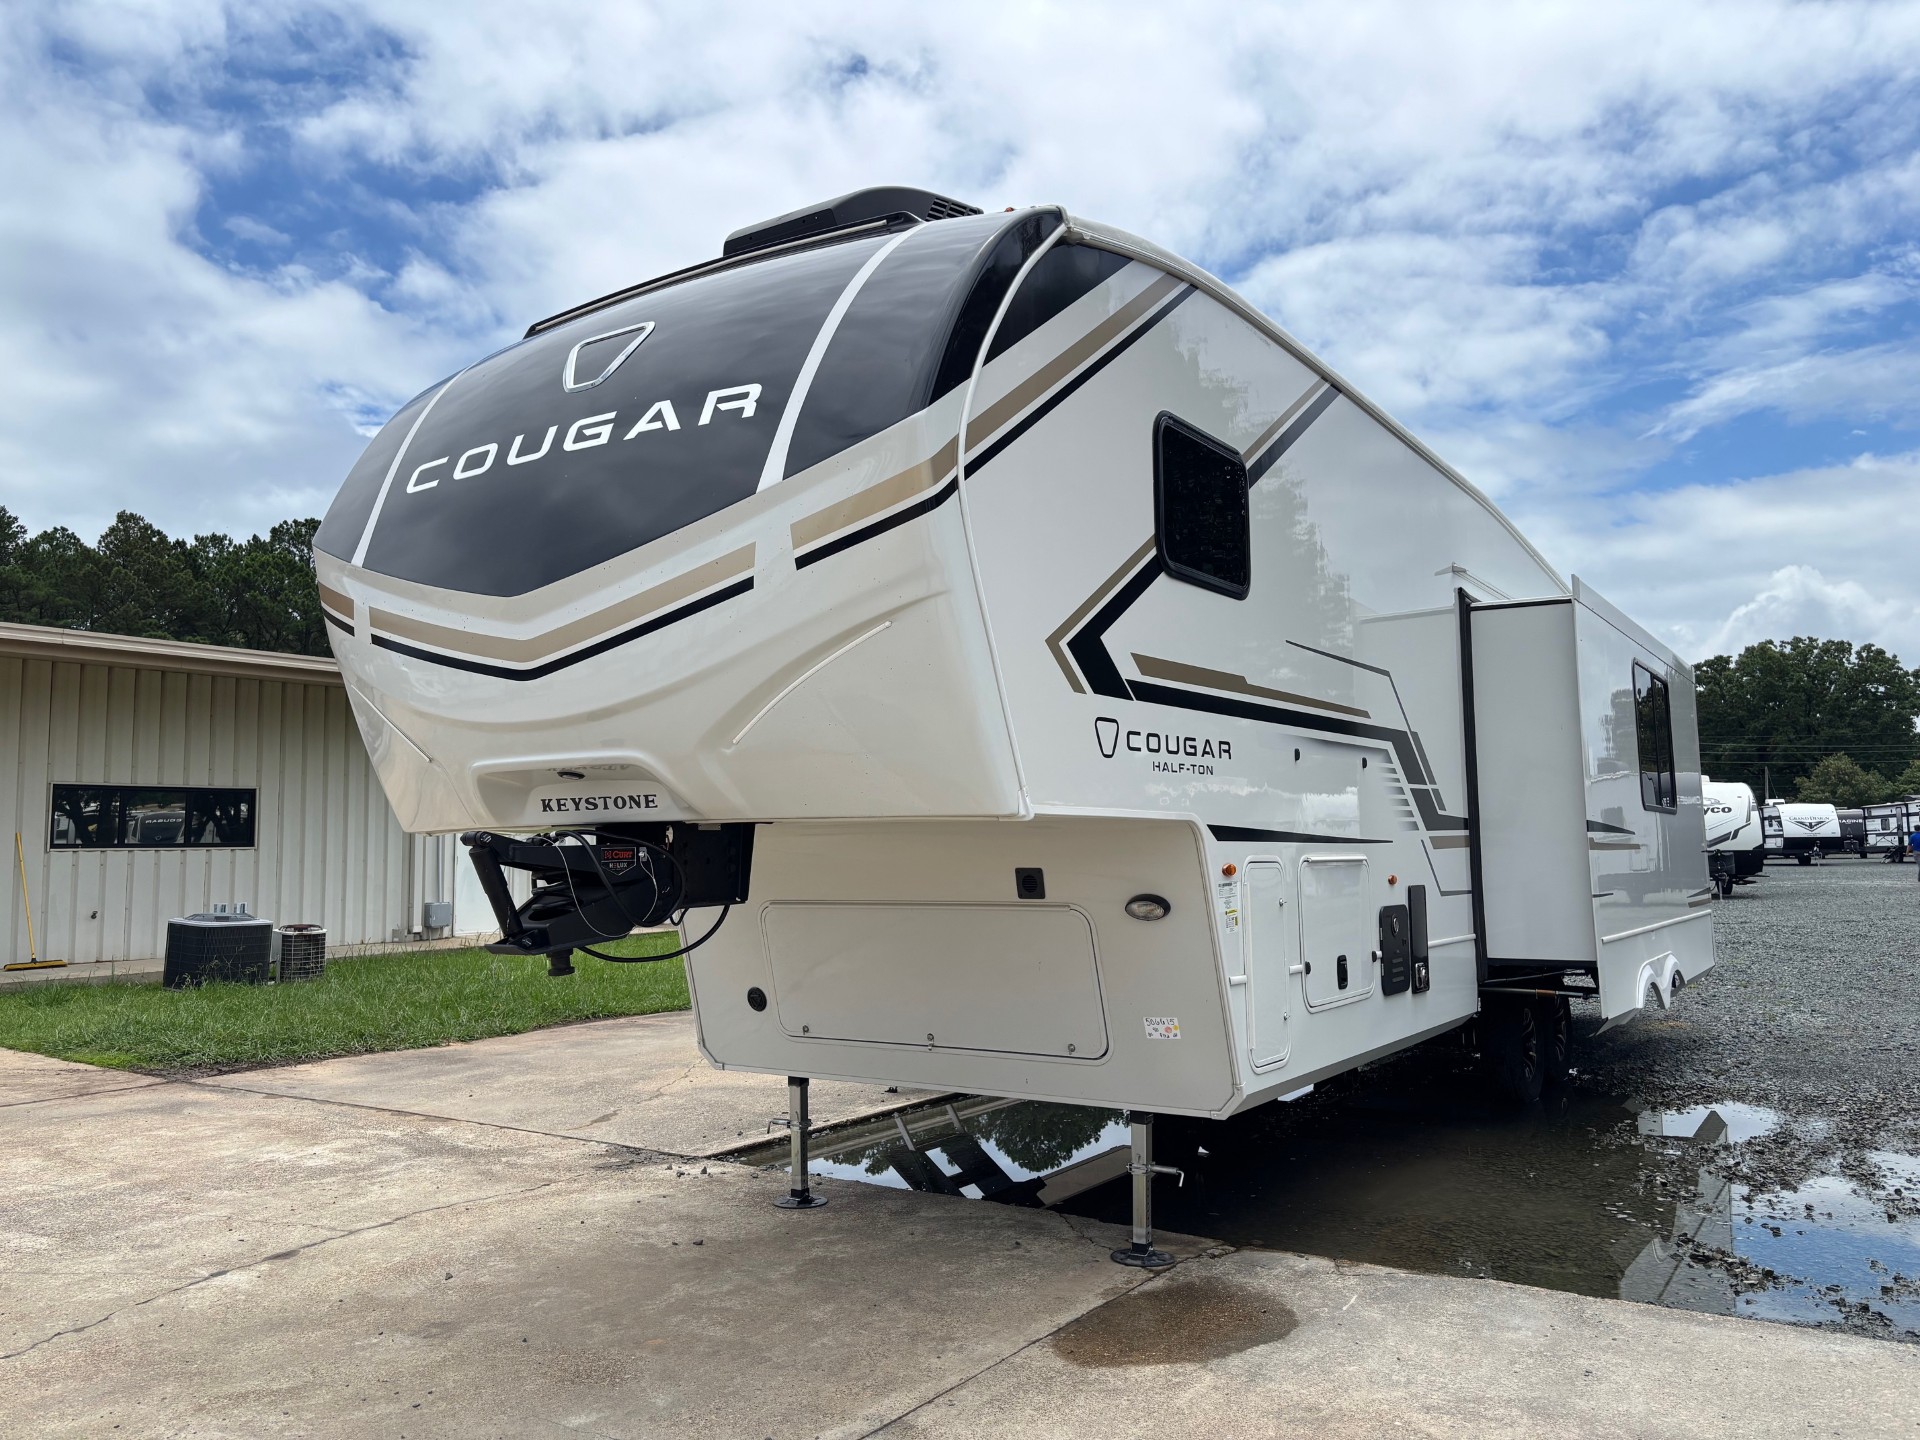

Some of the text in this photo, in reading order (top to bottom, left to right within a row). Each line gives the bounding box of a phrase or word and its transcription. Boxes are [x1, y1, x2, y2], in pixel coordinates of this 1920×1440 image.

[406, 383, 763, 494] COUGAR
[1126, 730, 1232, 760] COUGAR
[1152, 761, 1214, 776] HALF-TON
[540, 794, 658, 812] KEYSTONE
